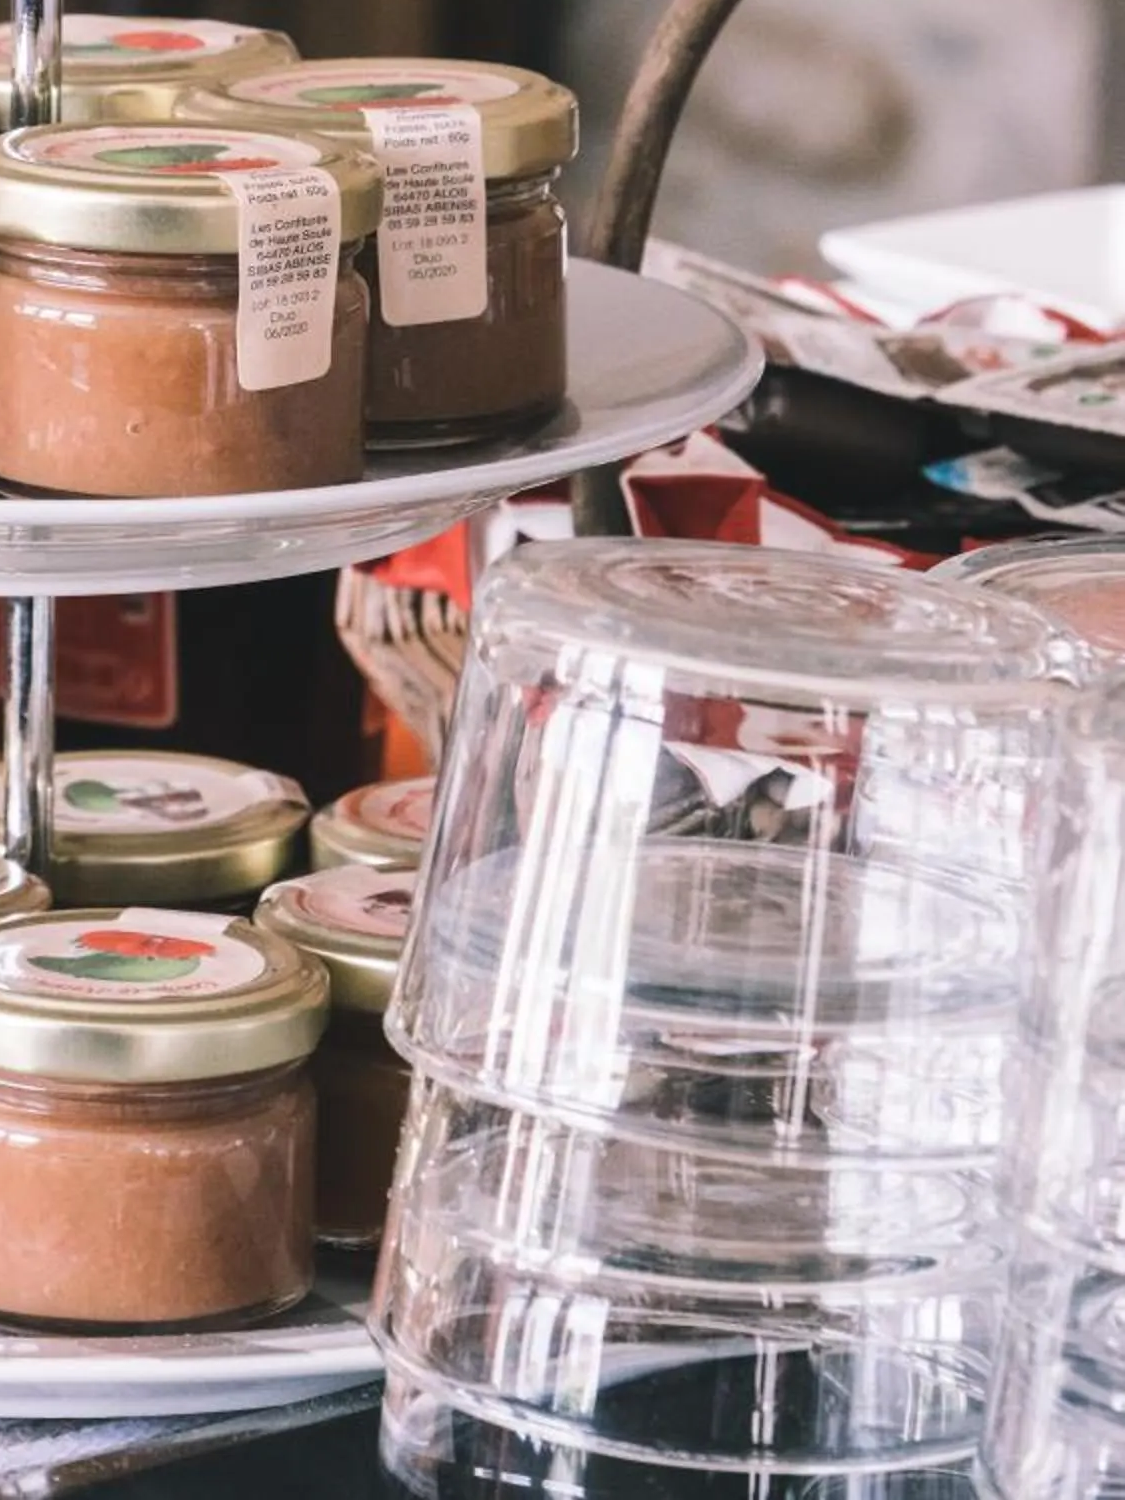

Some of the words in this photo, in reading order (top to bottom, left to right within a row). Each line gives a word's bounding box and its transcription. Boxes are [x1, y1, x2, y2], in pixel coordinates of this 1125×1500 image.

[411, 160, 469, 176] Confitures
[433, 187, 468, 199] ALOS
[424, 199, 477, 213] ABENSE
[274, 215, 328, 231] Confitures
[293, 242, 324, 255] ALOS
[247, 262, 282, 277] SIBAS
[283, 254, 332, 270] ABENSE
